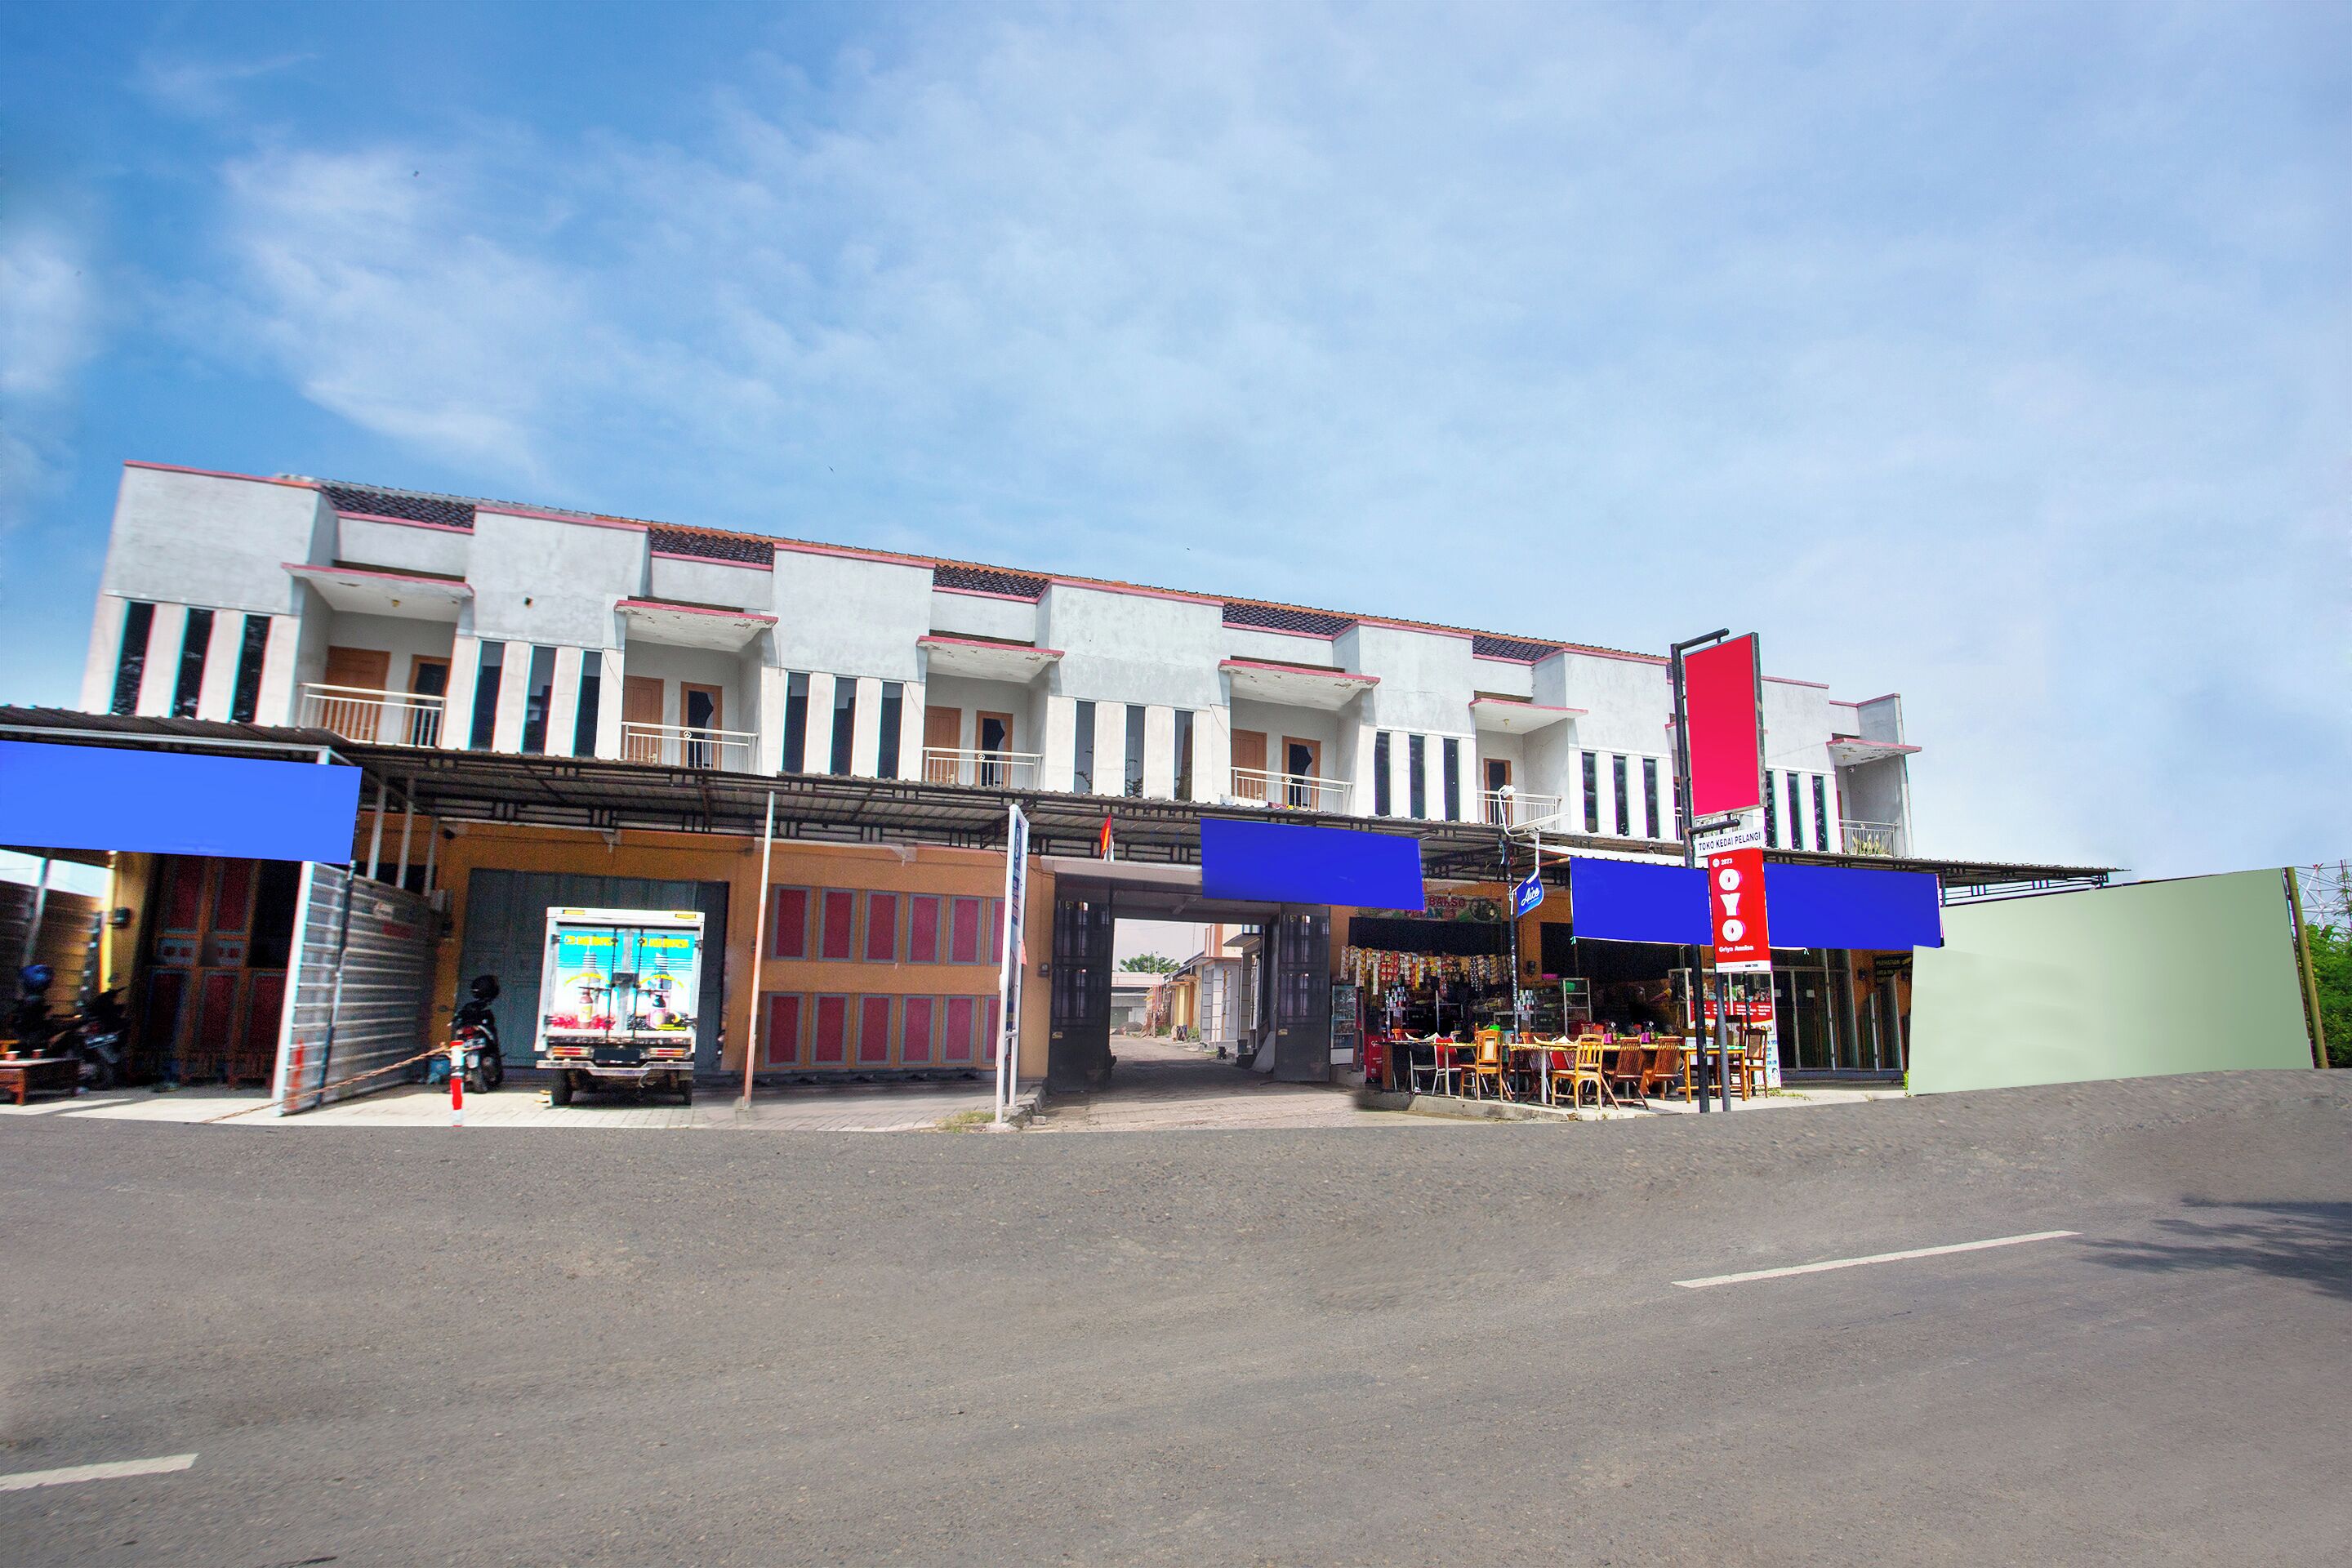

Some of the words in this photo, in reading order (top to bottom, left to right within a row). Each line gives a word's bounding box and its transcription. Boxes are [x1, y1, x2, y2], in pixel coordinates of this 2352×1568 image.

[1699, 840, 1715, 851] TOKO
[1716, 836, 1734, 848] KEDAI
[1735, 831, 1761, 844] PELANGI
[1428, 895, 1466, 907] BAKSO
[1521, 886, 1540, 906] Aice
[1718, 868, 1744, 942] OYO
[1718, 946, 1734, 954] Griya
